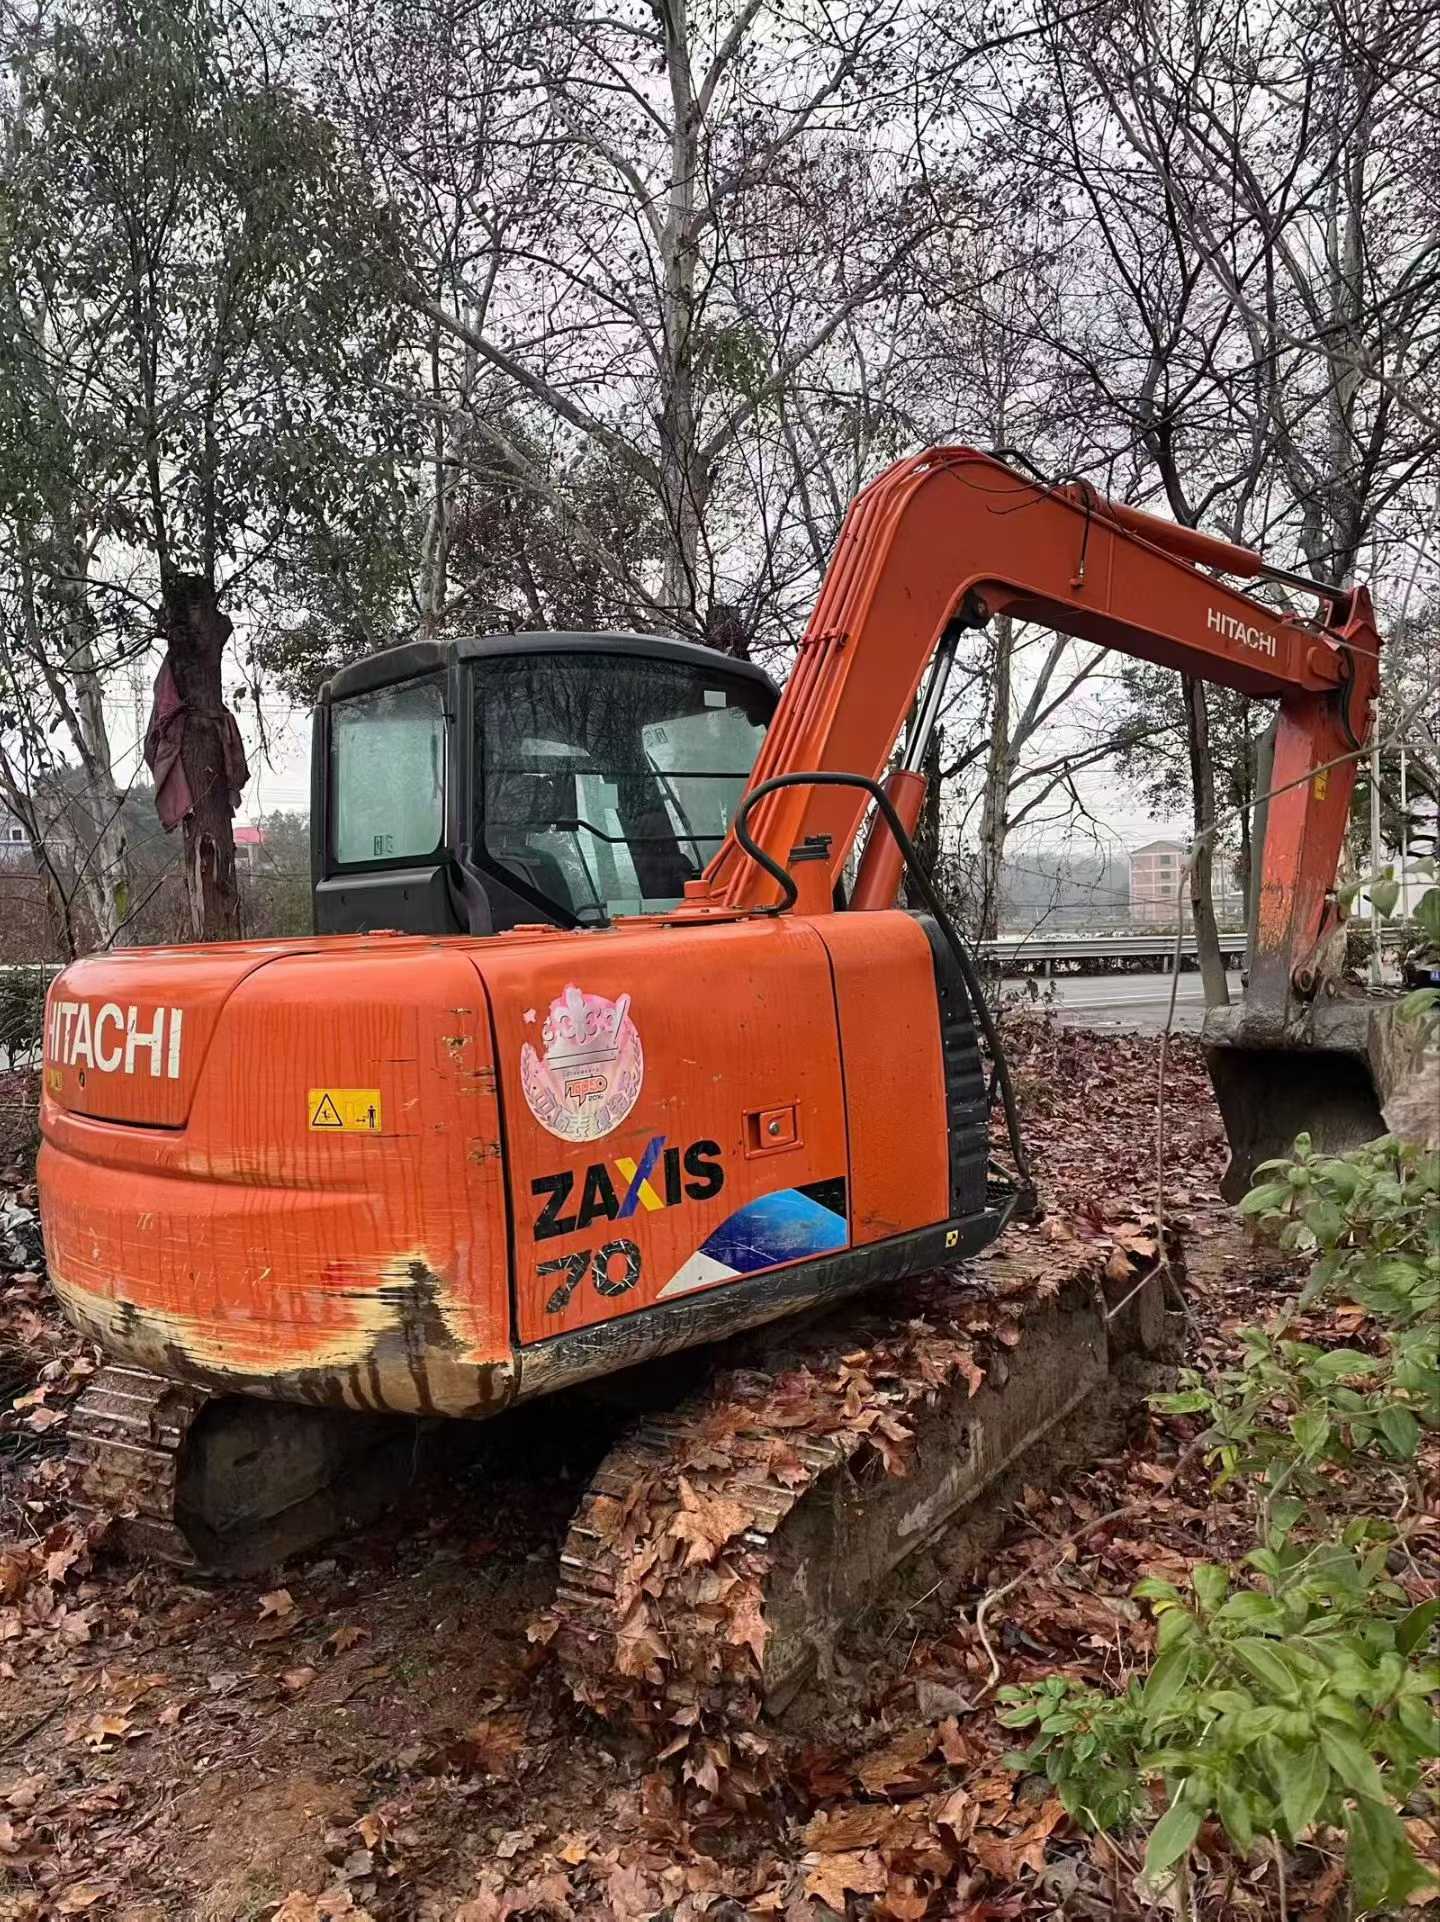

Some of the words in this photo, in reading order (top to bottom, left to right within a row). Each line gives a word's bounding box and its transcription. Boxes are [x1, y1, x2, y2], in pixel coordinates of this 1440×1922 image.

[1207, 607, 1276, 657] HITACHI
[48, 1001, 183, 1079] HITACHI
[531, 1135, 725, 1242] ZAXIS
[535, 1238, 642, 1314] 70
